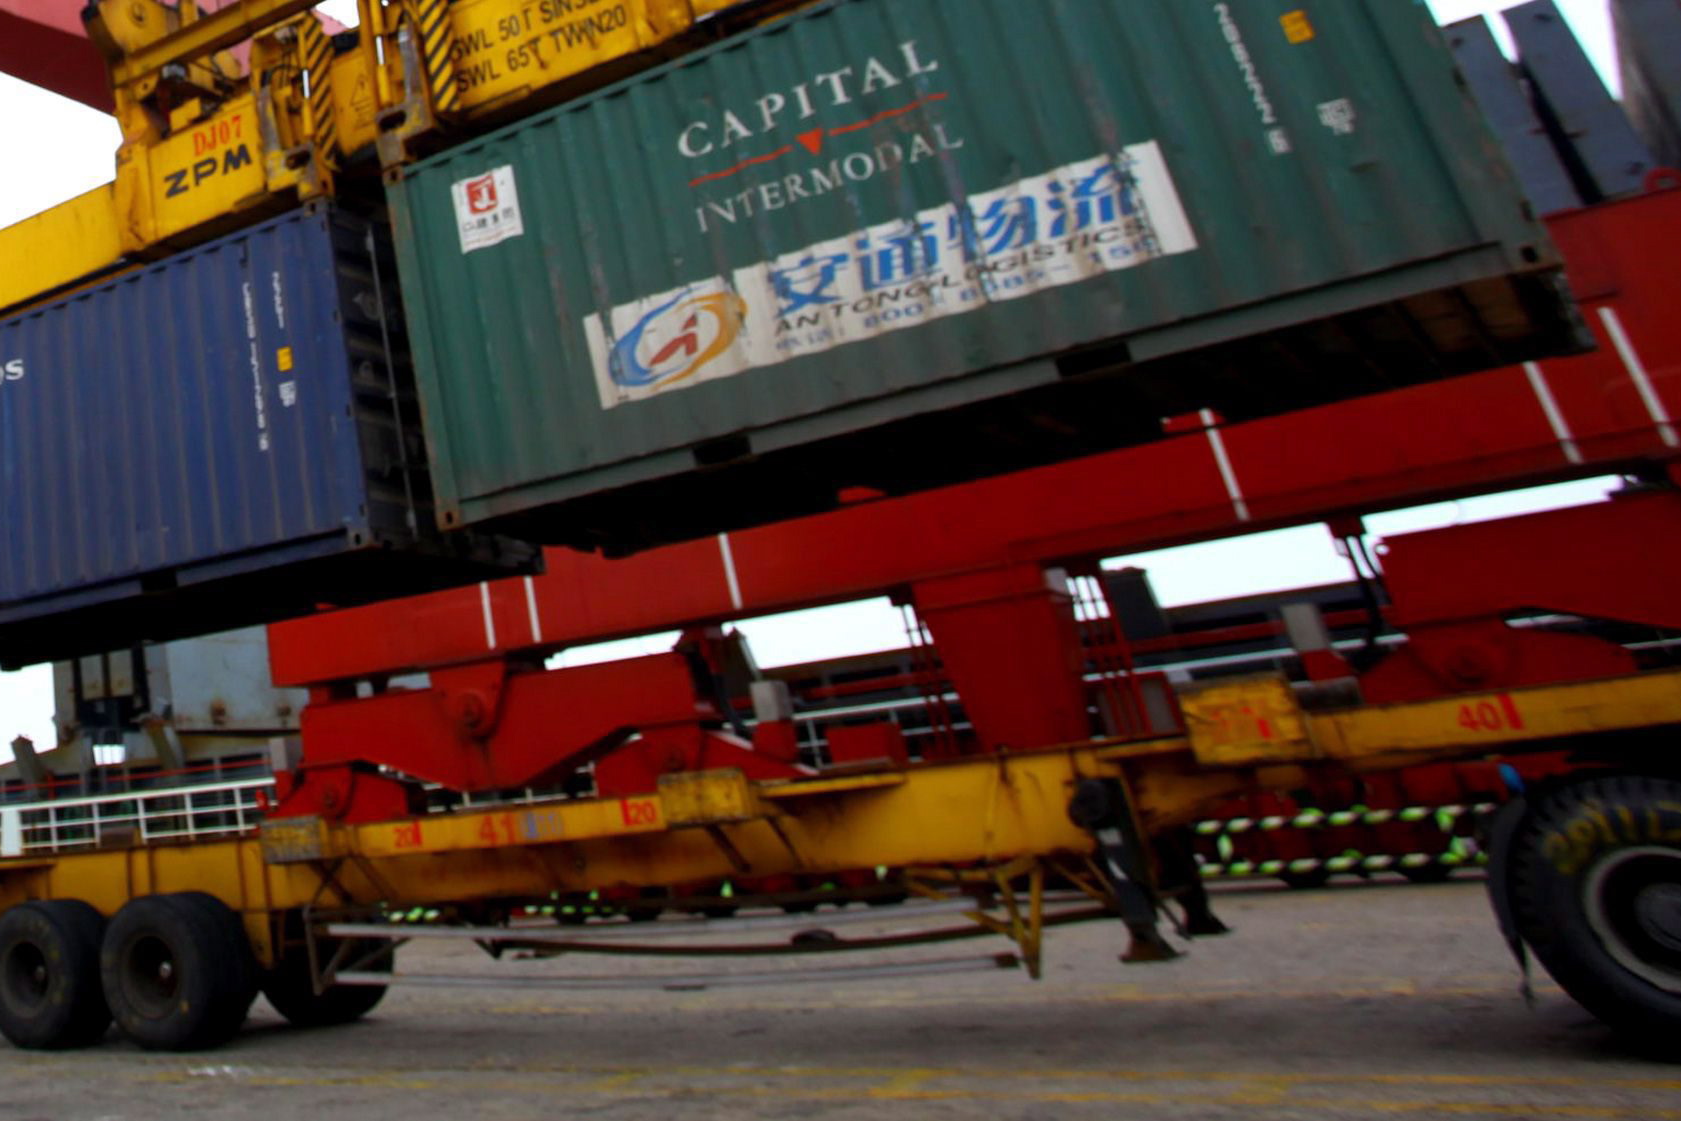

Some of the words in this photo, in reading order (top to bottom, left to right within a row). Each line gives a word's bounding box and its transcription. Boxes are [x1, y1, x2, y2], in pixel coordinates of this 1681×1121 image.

[456, 60, 501, 93] SWL
[677, 39, 939, 158] CAPITAL
[163, 143, 252, 199] ZPM
[193, 115, 241, 157] DJ07
[695, 123, 964, 233] INTERMODAL
[767, 161, 1138, 319] 安通物流
